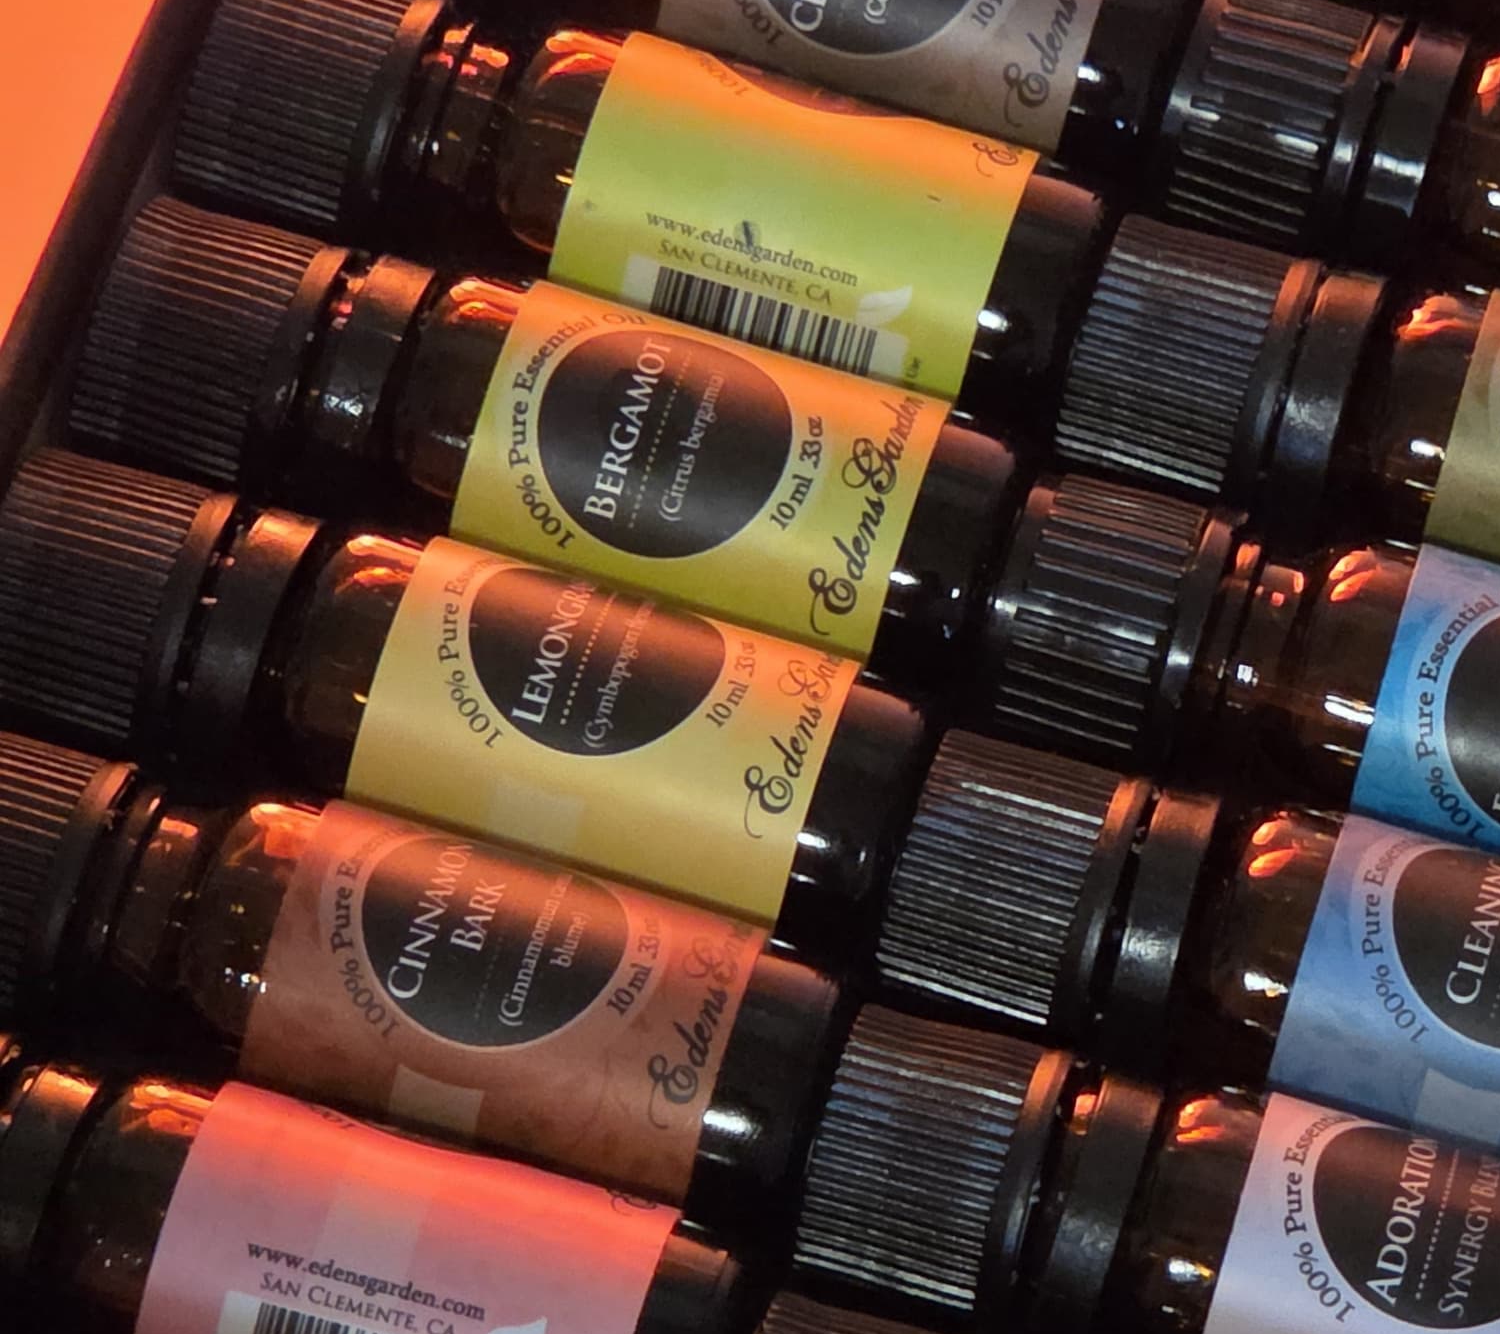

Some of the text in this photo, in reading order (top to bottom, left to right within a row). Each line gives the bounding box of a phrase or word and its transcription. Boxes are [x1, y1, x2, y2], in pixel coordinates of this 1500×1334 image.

[646, 210, 858, 288] www.edensgarden.com
[658, 239, 833, 306] SAN CLEMENTE, CA
[509, 318, 600, 552] 100% Pure Essential
[583, 339, 672, 522] BERGAMOT
[659, 447, 698, 523] (Citrus
[769, 500, 796, 531] 10
[789, 475, 815, 510] ml
[806, 416, 826, 438] oz
[808, 394, 927, 636] Edens Garden
[437, 600, 506, 751] 100% Pure
[1416, 597, 1498, 683] Essential
[743, 695, 823, 839] Edens
[1415, 689, 1436, 762] Pure
[1427, 765, 1485, 841] 100%
[330, 885, 401, 1040] 100% Pure
[450, 880, 508, 953] BARK
[1362, 890, 1431, 1045] 100% Pure
[646, 987, 729, 1130] Edens
[246, 1241, 486, 1322] www.edensgarden.com
[259, 1272, 302, 1301] SAN
[306, 1284, 420, 1333] CLEMENTE,
[1284, 1169, 1357, 1325] 100% Pure
[1437, 1196, 1494, 1321] SYNERGY
